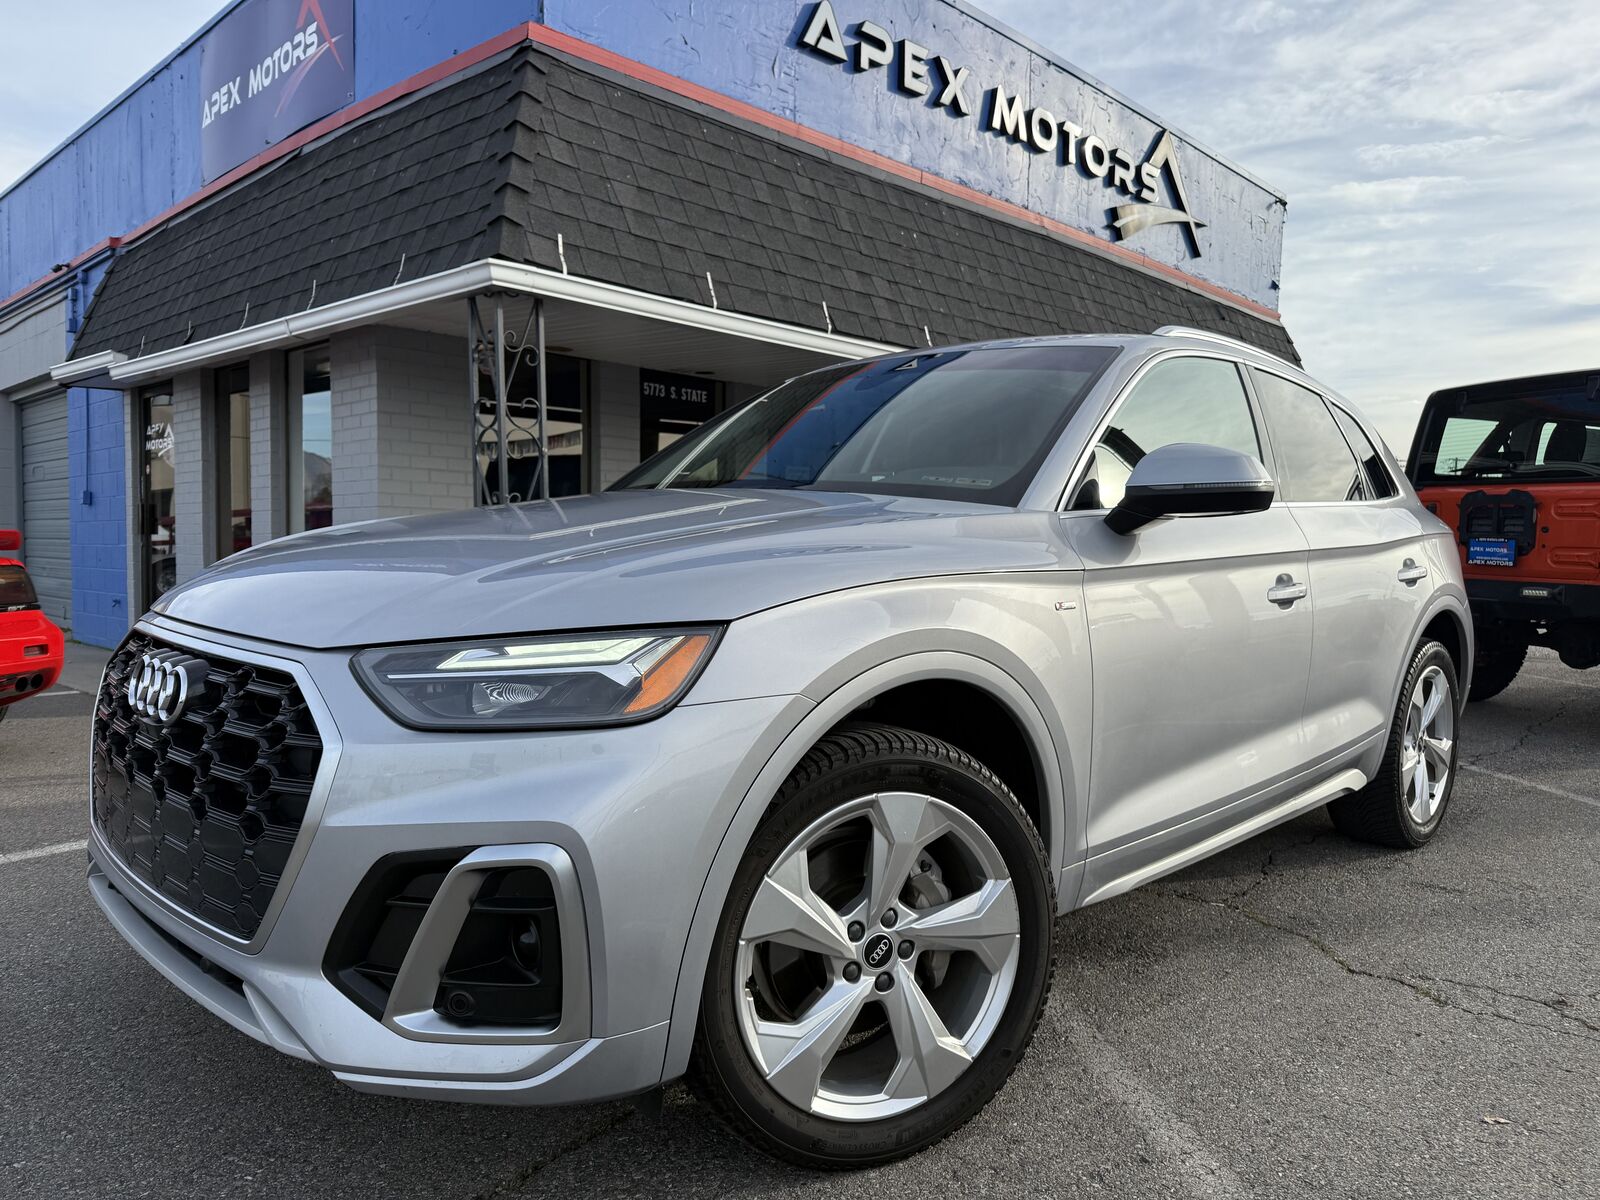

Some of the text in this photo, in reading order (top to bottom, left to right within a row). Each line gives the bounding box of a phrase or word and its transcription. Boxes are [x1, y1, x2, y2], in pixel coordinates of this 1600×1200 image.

[201, 21, 318, 129] APEX MOTORS
[801, 0, 1161, 202] APEX MOTORS
[643, 382, 708, 403] 5773 S. STATE
